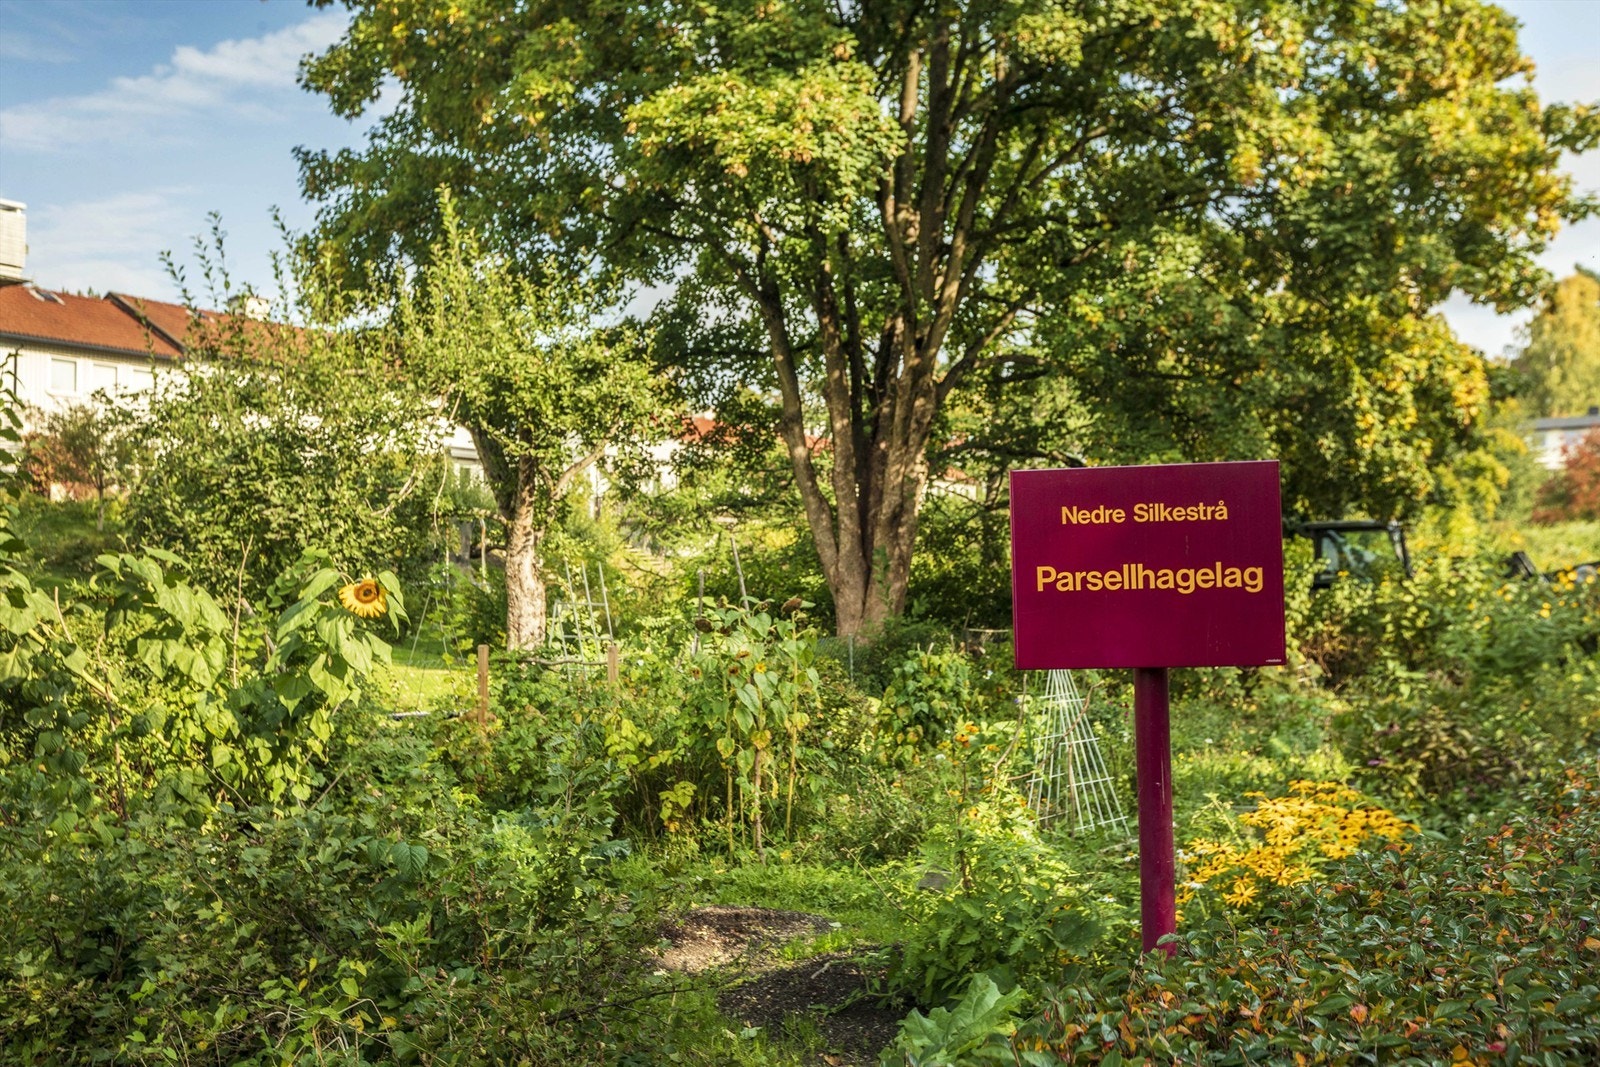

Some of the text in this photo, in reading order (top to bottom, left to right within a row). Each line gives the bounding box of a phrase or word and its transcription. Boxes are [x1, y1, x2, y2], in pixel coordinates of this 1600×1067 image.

[1061, 500, 1228, 525] Nedre Silkestrå
[1036, 561, 1263, 594] Parsellhagelag
